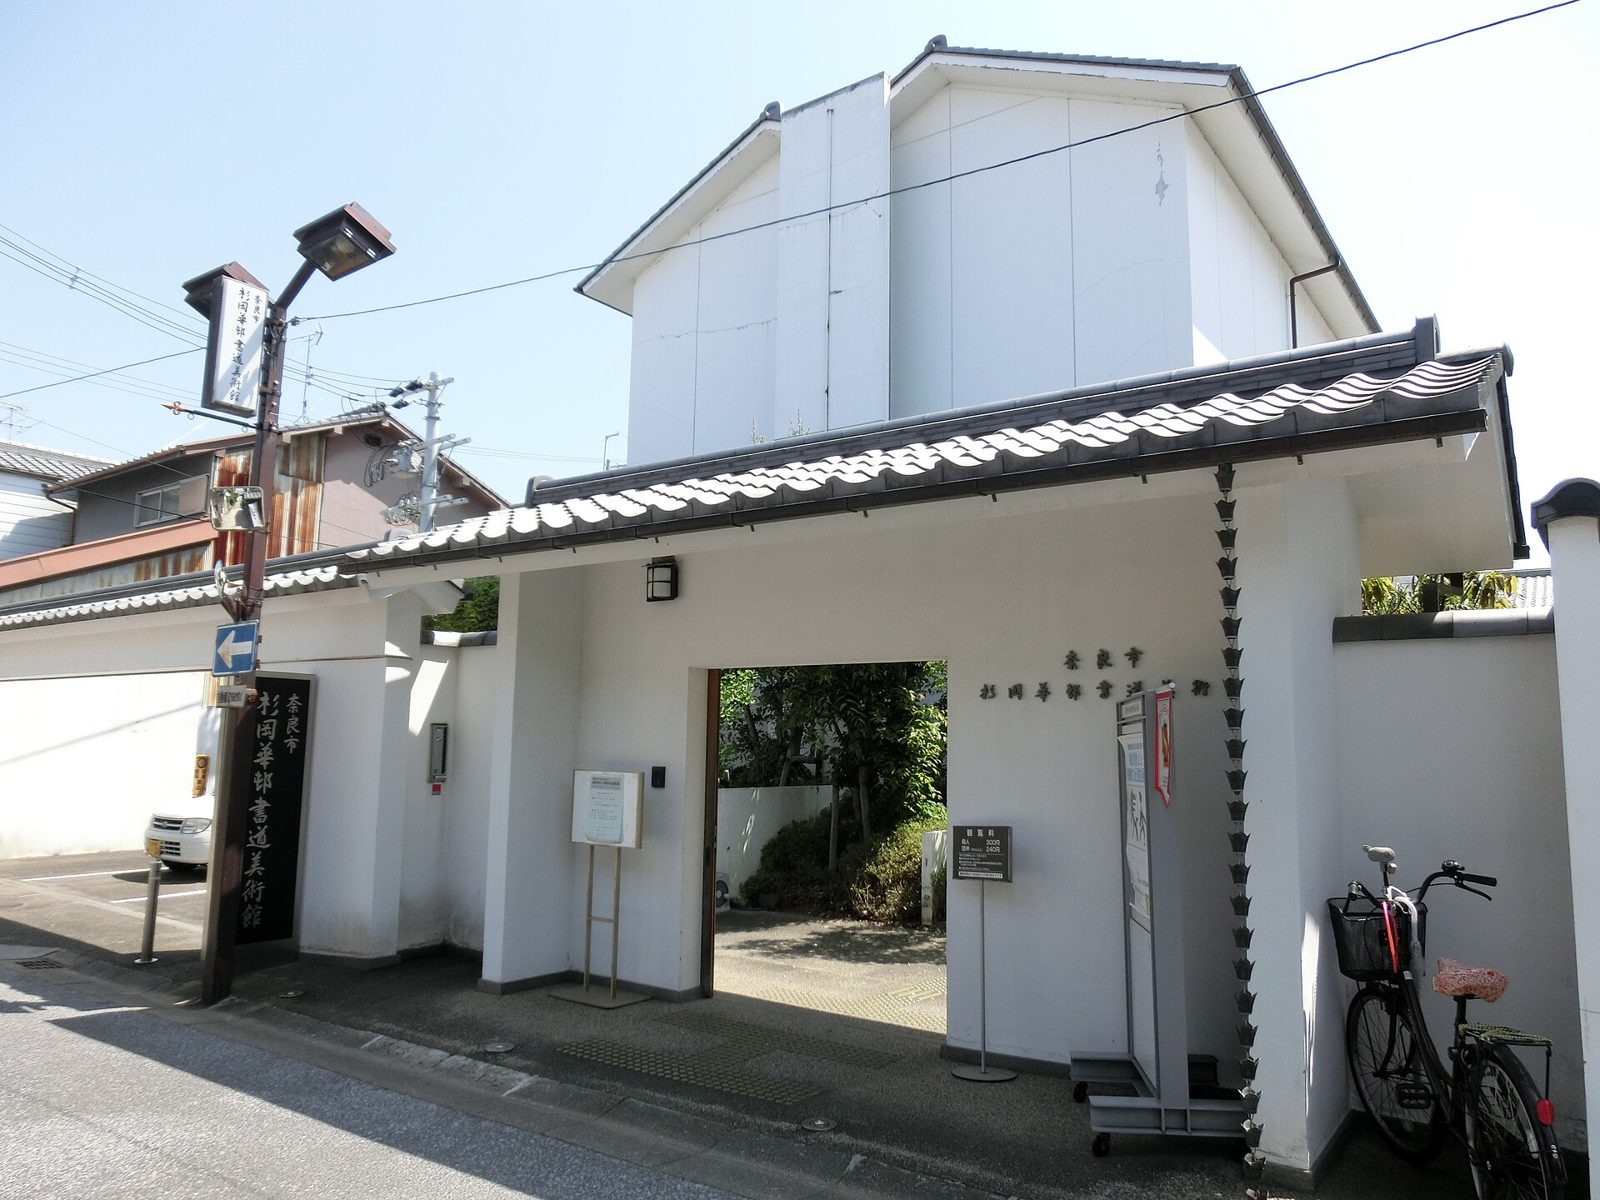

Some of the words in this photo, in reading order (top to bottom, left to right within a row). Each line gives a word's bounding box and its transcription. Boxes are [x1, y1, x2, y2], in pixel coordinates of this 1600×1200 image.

[284, 693, 302, 754] 奈良市
[241, 690, 280, 929] 杉岡華邨書道美術館
